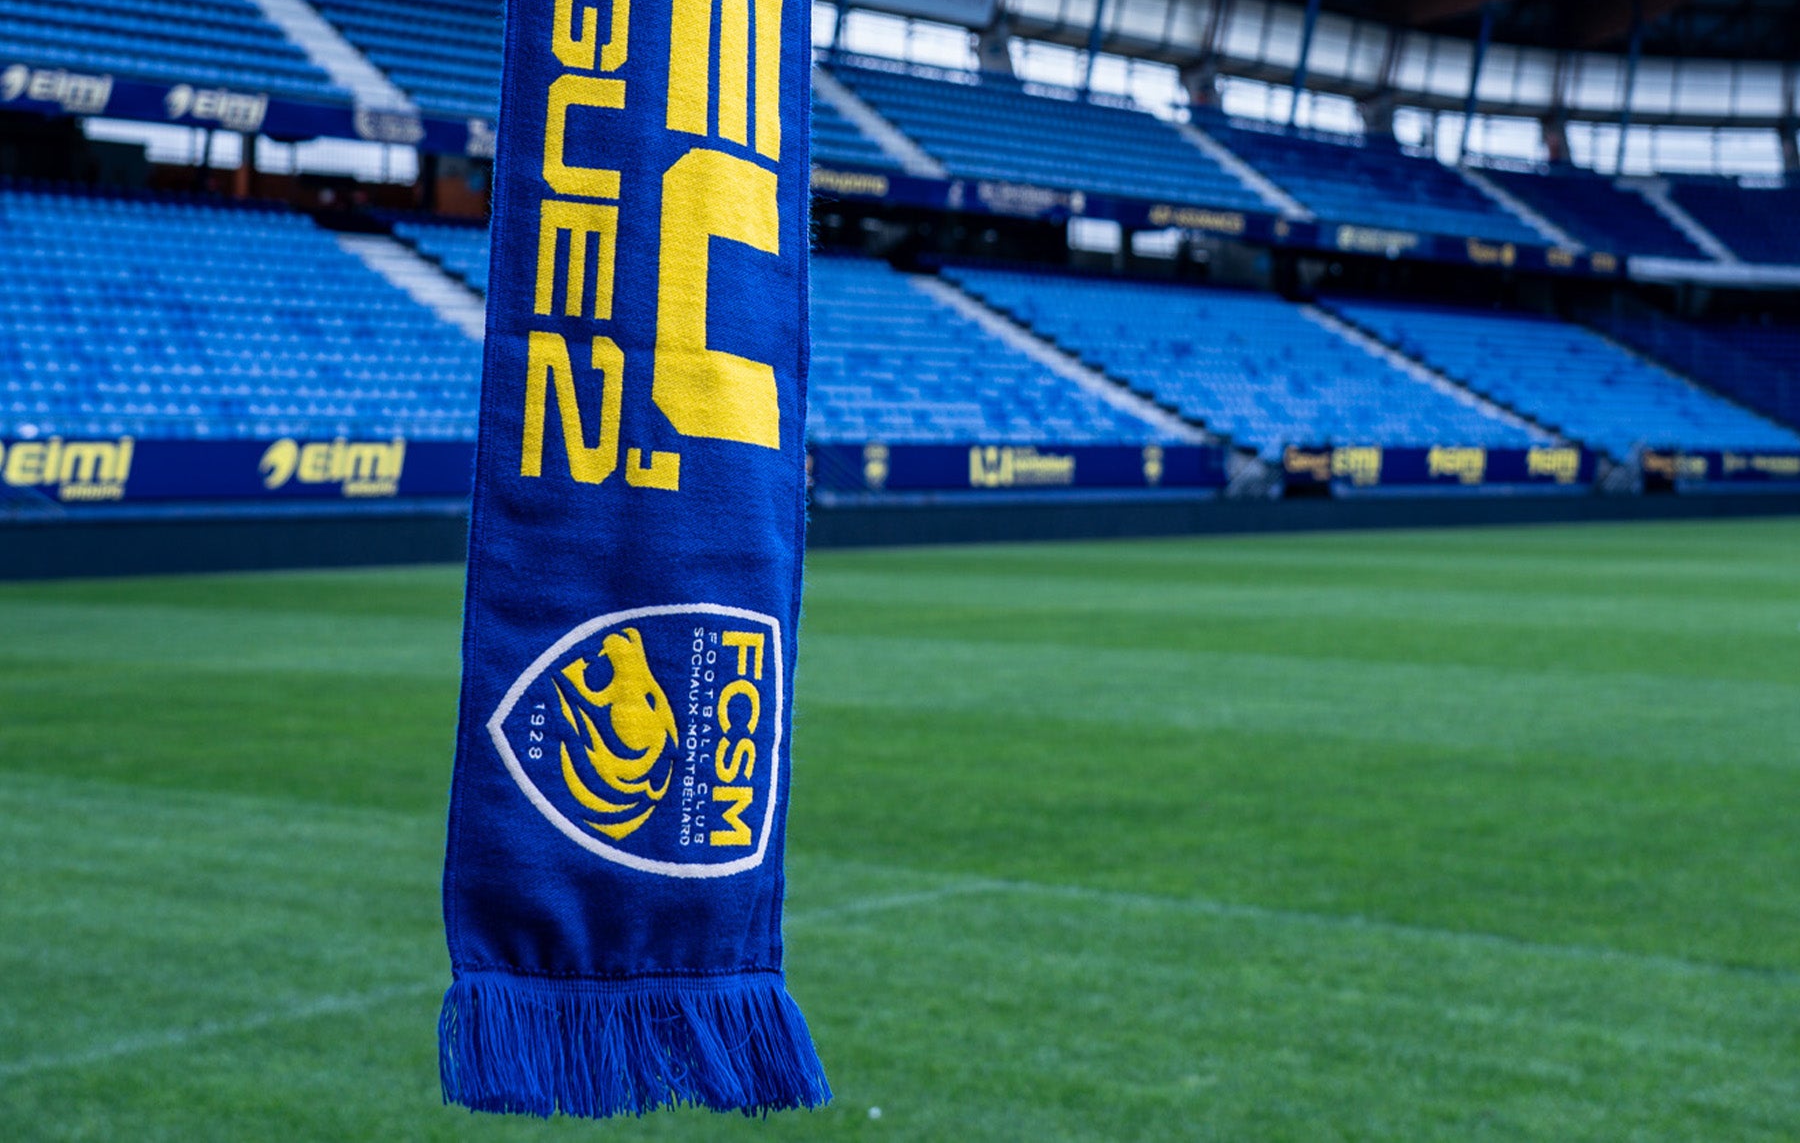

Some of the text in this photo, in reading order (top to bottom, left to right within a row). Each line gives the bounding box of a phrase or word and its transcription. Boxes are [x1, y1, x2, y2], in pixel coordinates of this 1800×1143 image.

[528, 702, 546, 761] 1928
[693, 631, 718, 846] FOOTBALL CLUB
[709, 629, 766, 848] FCSM
